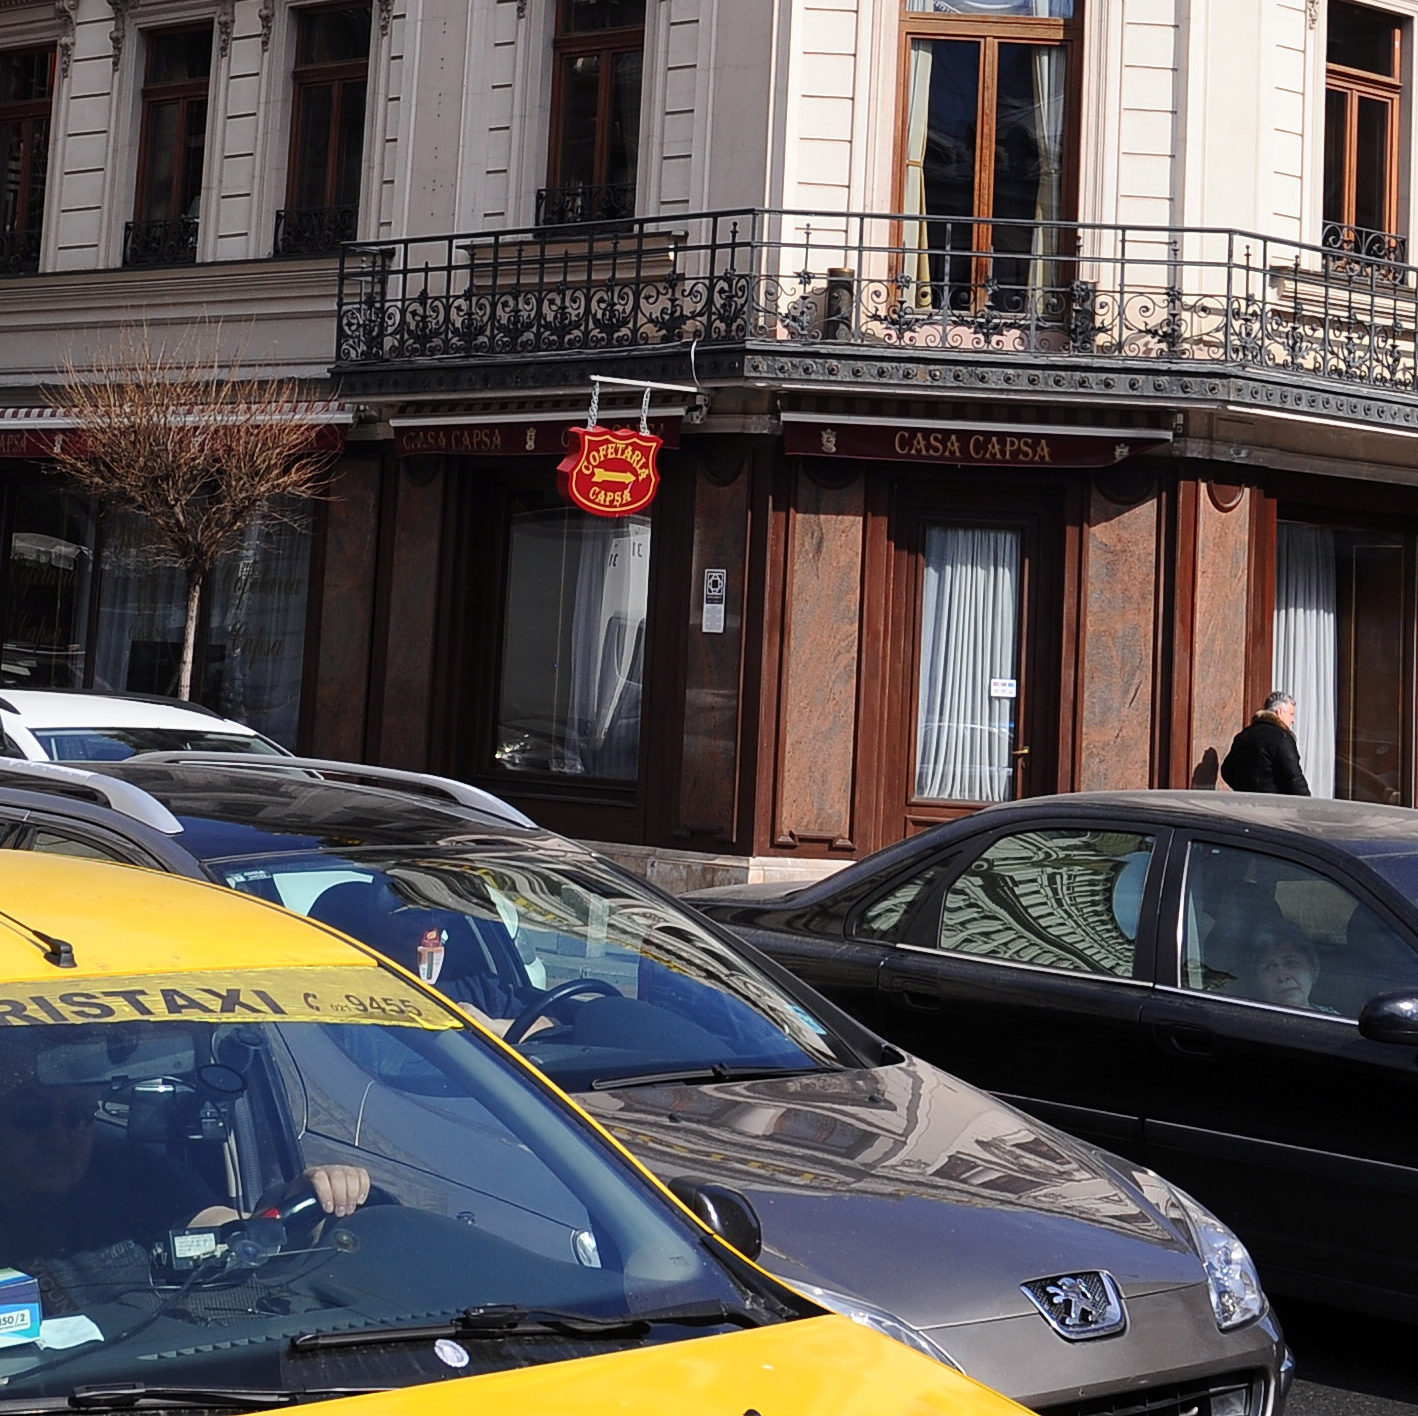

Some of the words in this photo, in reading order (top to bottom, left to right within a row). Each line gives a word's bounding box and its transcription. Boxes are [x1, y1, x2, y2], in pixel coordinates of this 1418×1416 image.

[451, 429, 501, 451] CAPSA
[894, 431, 962, 457] CASA
[969, 435, 1053, 462] CAPSA
